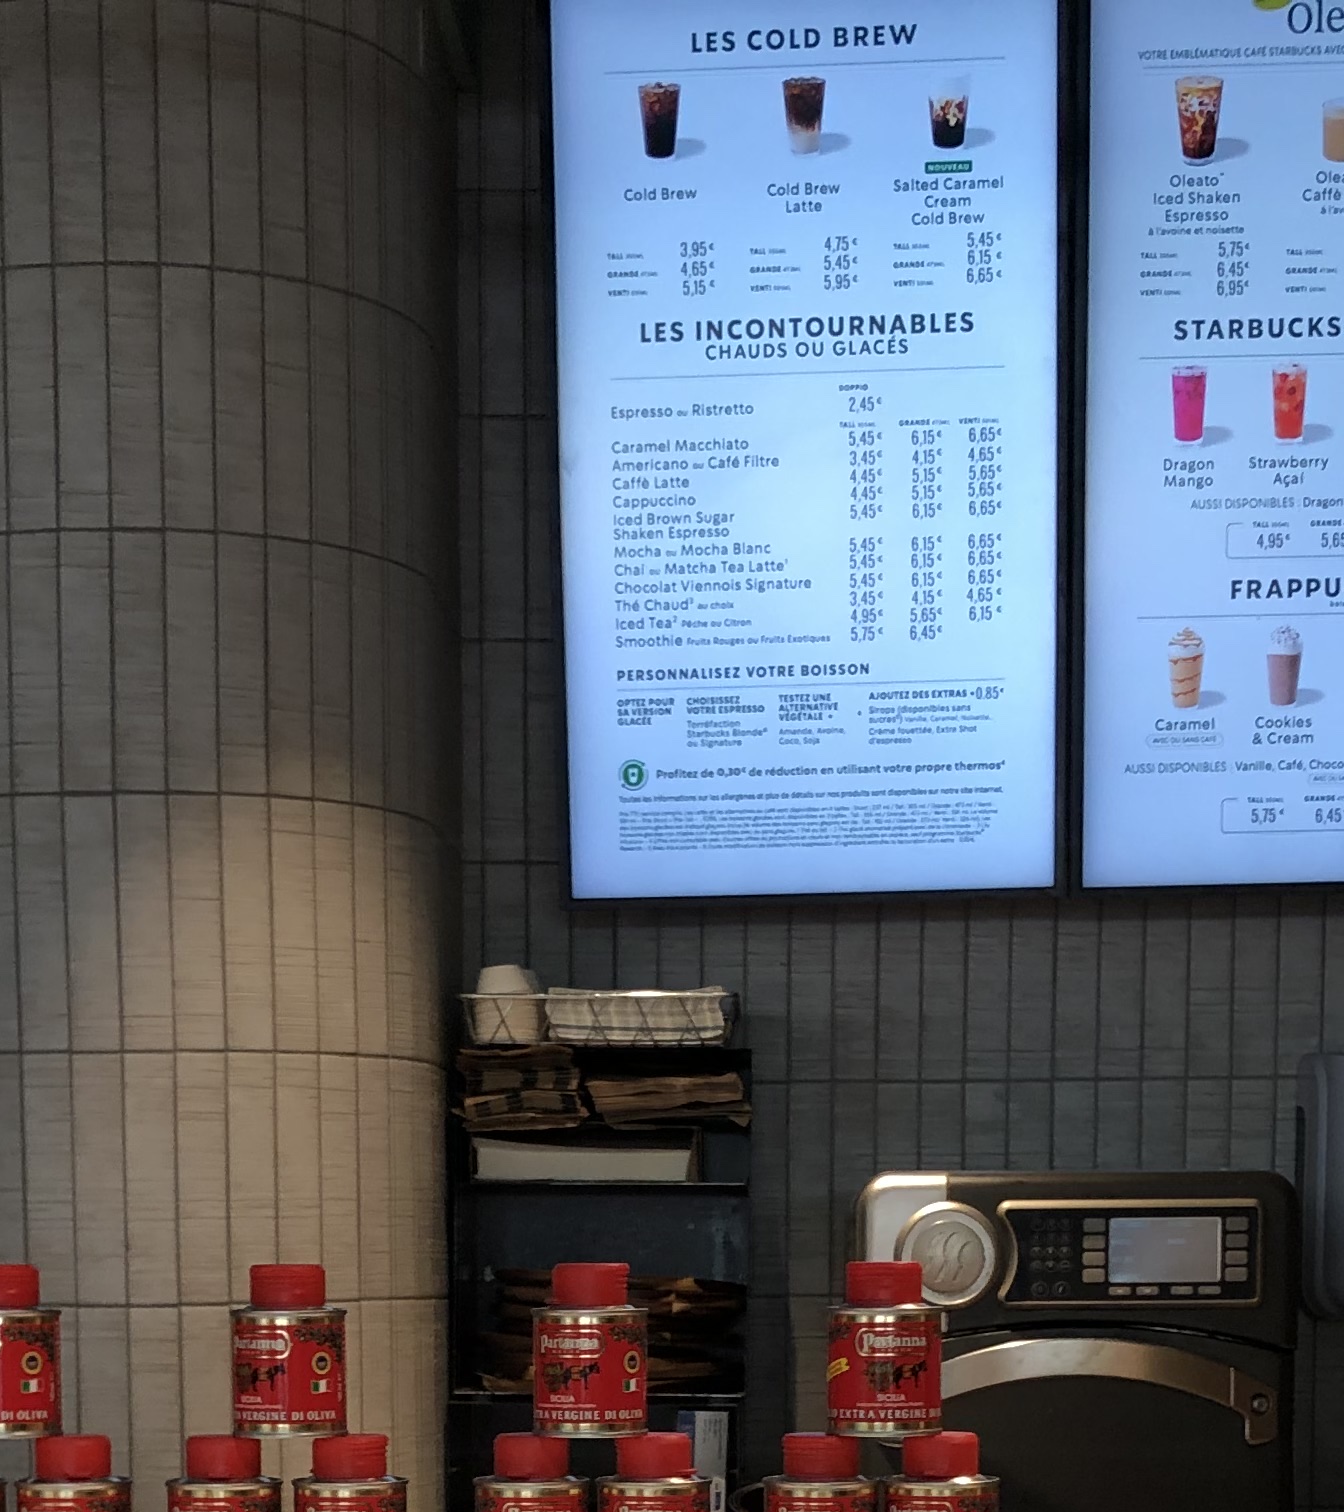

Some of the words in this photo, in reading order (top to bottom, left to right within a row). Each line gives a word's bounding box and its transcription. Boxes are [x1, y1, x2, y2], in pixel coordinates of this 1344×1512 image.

[691, 31, 736, 54] LES
[747, 27, 821, 51] COLD
[833, 23, 918, 48] BREW
[767, 183, 800, 197] Cold
[805, 181, 840, 196] Brew
[893, 177, 939, 192] Salted
[943, 176, 1004, 191] Caramel
[623, 188, 657, 202] Cold
[661, 186, 698, 201] Brew
[924, 194, 972, 209] Cream
[1153, 192, 1183, 205] Iced
[1188, 191, 1240, 204] Shaken
[785, 200, 823, 214] Latte
[911, 211, 943, 226] Cold
[947, 211, 985, 225] Brew
[1165, 209, 1229, 225] Espresso
[640, 322, 684, 342] LES
[696, 312, 975, 341] INCONTOURNABLES
[1174, 316, 1341, 341] STARBUCKS
[705, 342, 788, 360] CHAUDS
[795, 340, 825, 357] OU
[833, 335, 909, 356] GLACÉS
[611, 406, 673, 421] Espresso
[692, 403, 754, 416] Ristretto
[611, 440, 671, 454] Caramel
[675, 438, 749, 451] Macchiato
[612, 459, 689, 471] Americano
[708, 456, 740, 469] Café
[744, 455, 780, 467] Filtre
[1163, 458, 1215, 474] Dragon
[1249, 456, 1329, 471] Strawberry
[654, 476, 690, 489] Latte
[1164, 475, 1214, 490] Mango
[613, 494, 696, 510] Cappuccino
[613, 513, 643, 526] Iced
[647, 512, 691, 525] Brown
[696, 511, 735, 526] Sugar
[617, 668, 740, 681] PERSONNALISEZ
[746, 665, 795, 677] VOTRE
[801, 663, 870, 676] BOISSON
[1155, 718, 1215, 732] Caramel
[1255, 716, 1312, 729] Cookies
[1267, 731, 1314, 744] Cream
[540, 1331, 600, 1354] Partanna
[863, 1328, 927, 1351] Partanna
